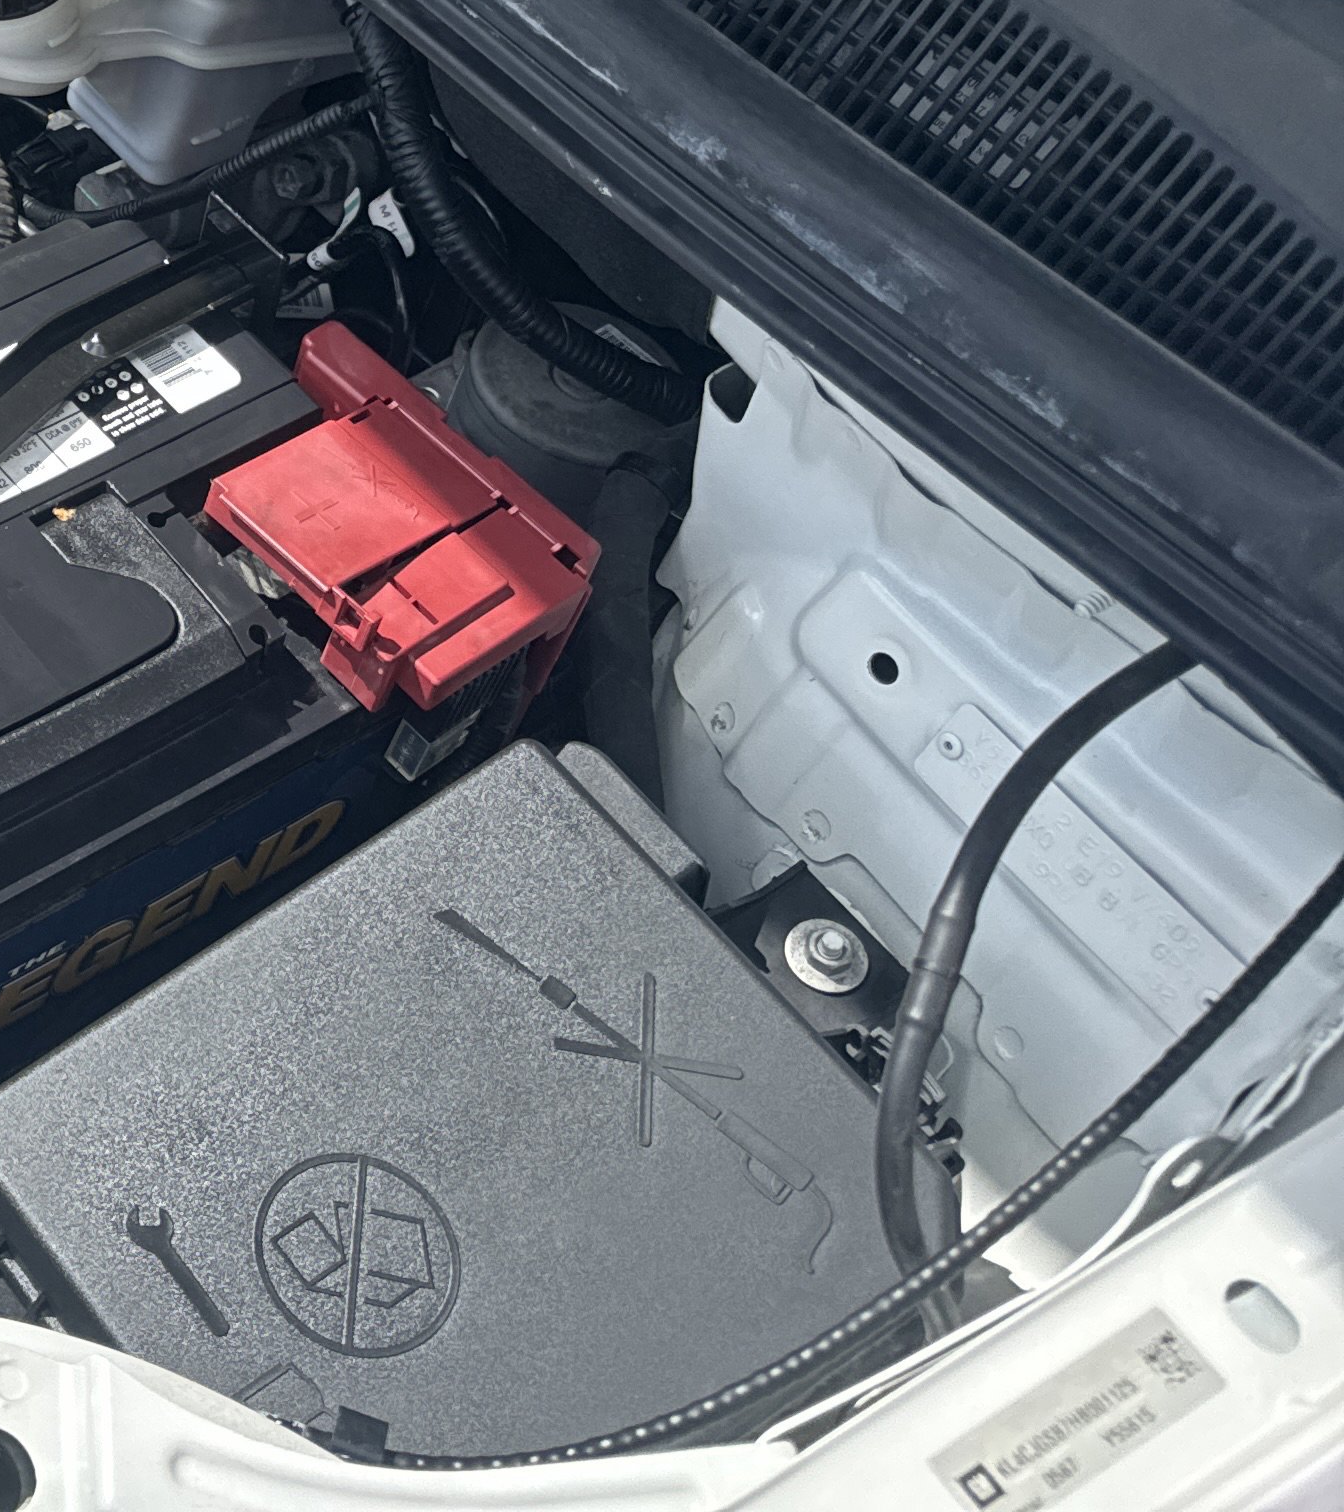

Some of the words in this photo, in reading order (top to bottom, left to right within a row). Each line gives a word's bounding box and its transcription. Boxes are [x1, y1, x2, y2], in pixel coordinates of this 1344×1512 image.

[44, 426, 63, 441] CCA
[69, 438, 92, 452] 650
[7, 940, 67, 979] THE
